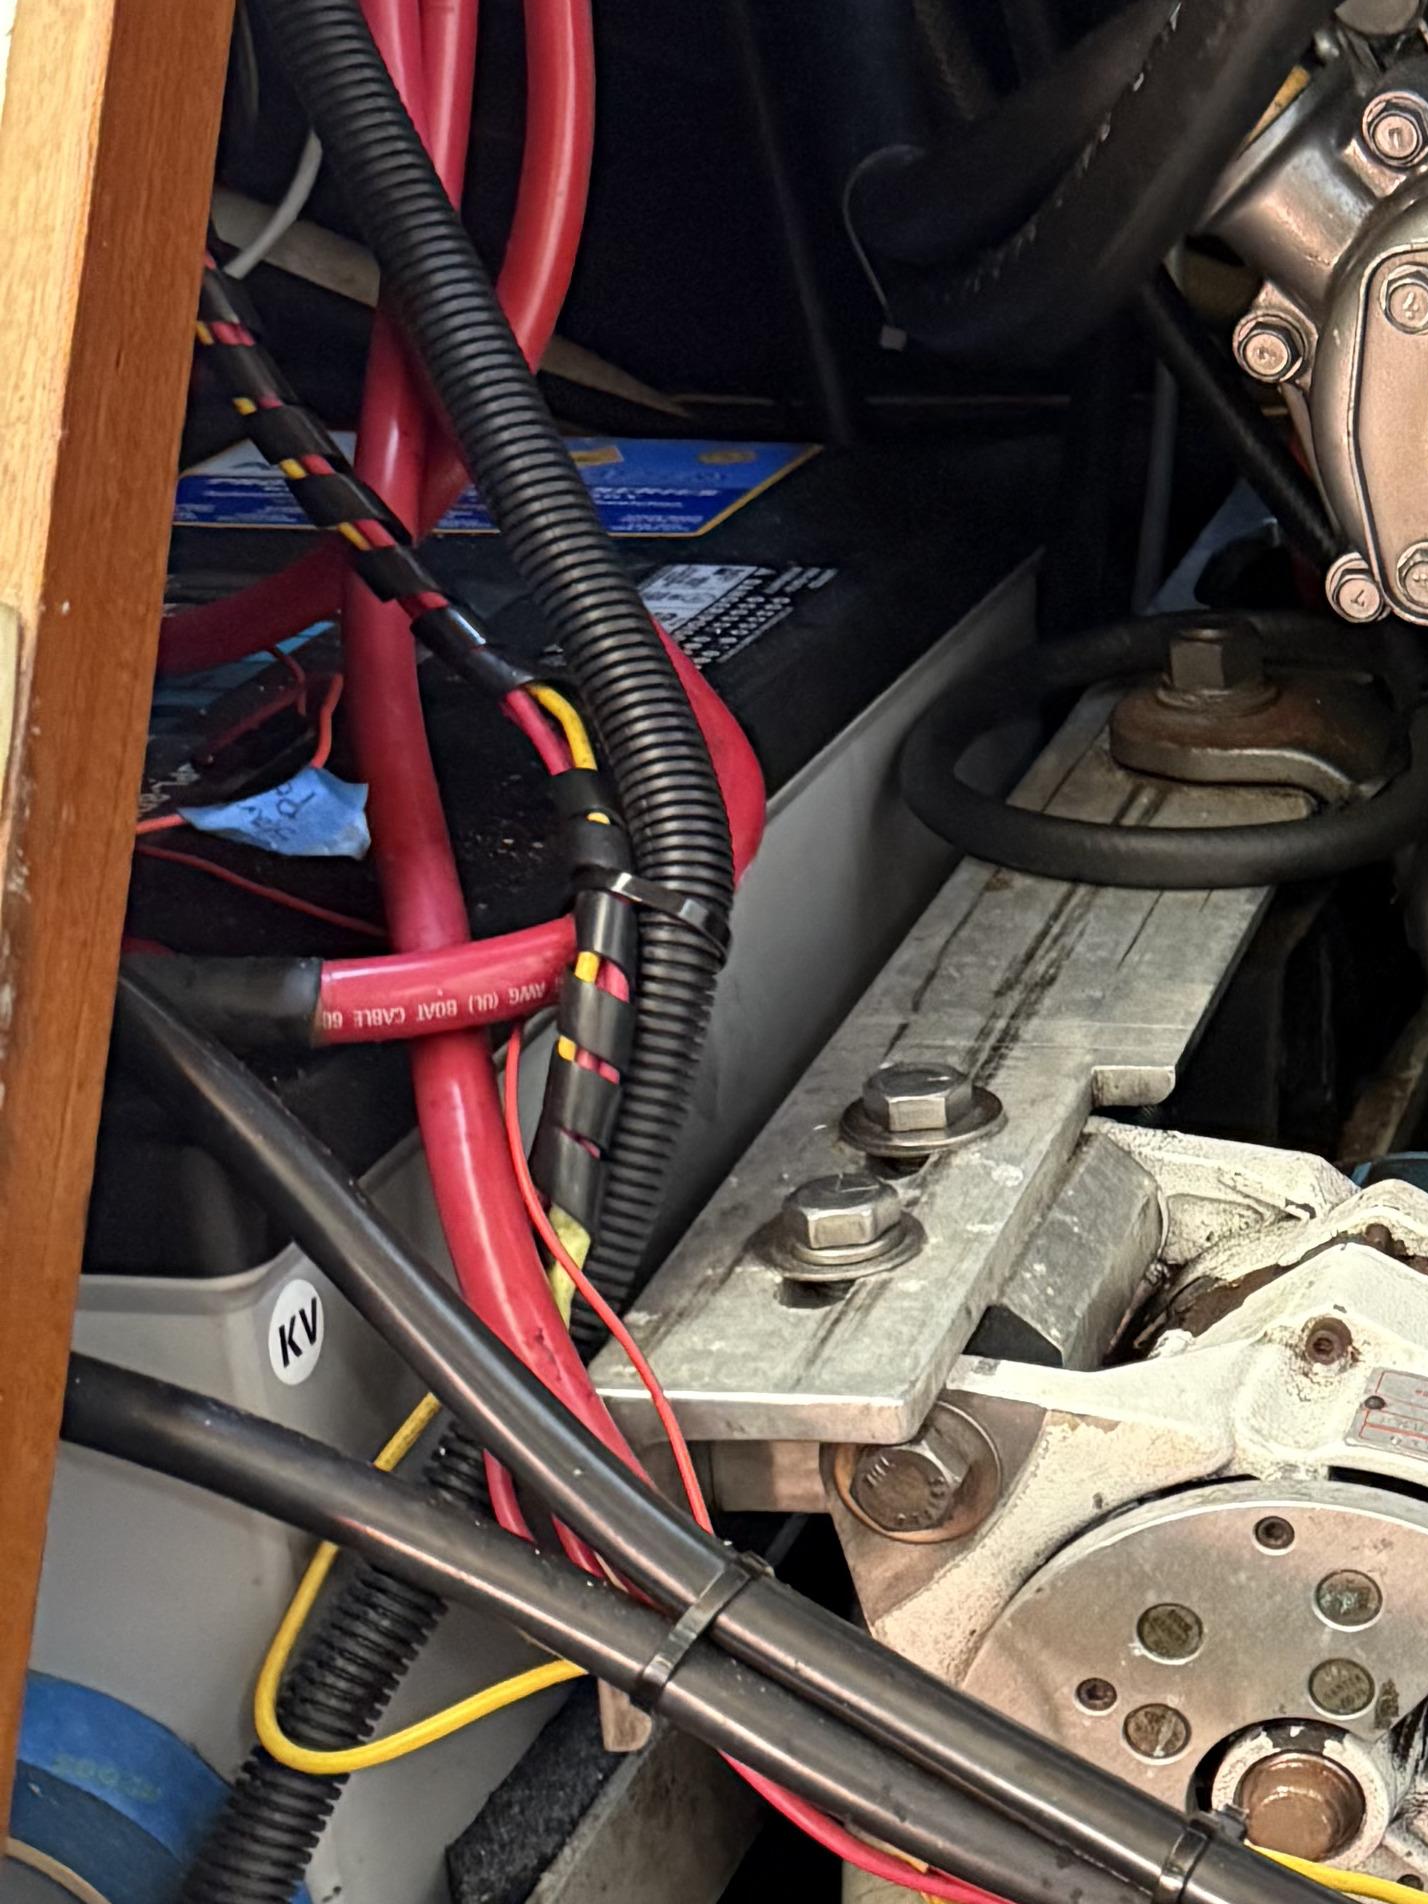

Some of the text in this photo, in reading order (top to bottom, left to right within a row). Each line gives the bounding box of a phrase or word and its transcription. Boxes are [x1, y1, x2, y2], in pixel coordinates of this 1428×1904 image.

[468, 991, 499, 1017] (UL)
[508, 980, 547, 1005] AWG
[353, 1006, 406, 1029] CABLE
[416, 998, 458, 1023] BOAT
[279, 1296, 317, 1369] KV
